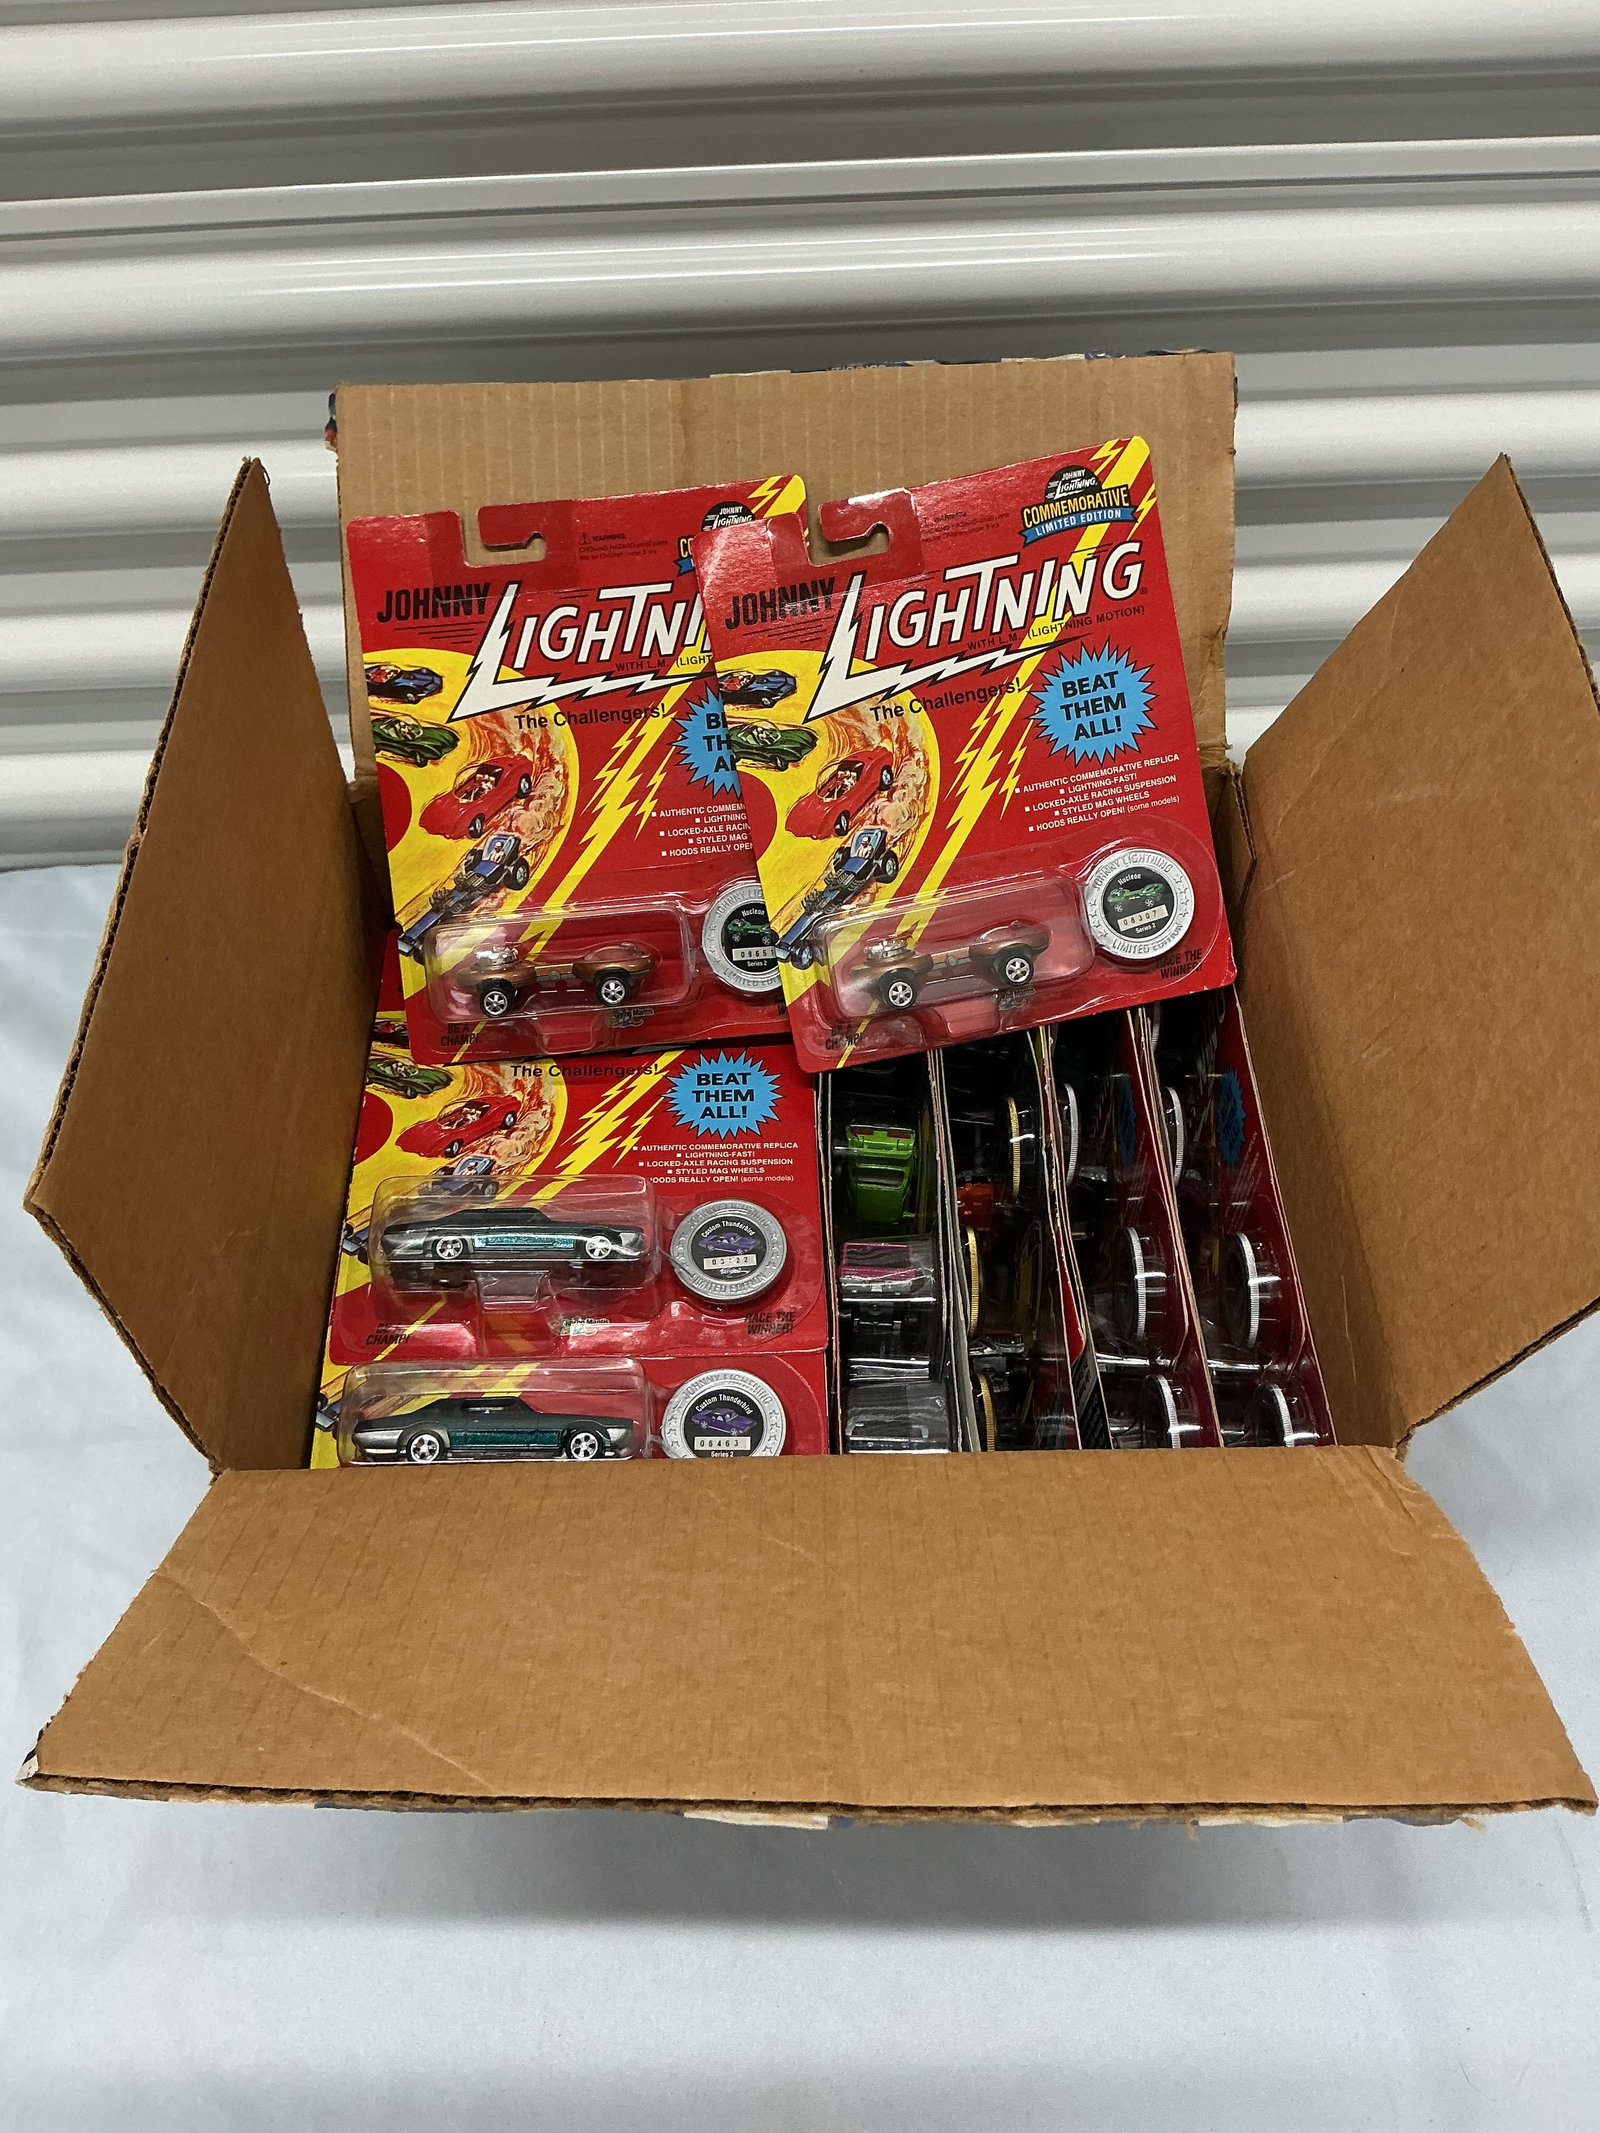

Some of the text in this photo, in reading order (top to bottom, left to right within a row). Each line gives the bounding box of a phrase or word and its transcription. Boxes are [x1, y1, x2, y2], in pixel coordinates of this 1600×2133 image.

[1061, 469, 1086, 480] JOHNNY
[1054, 477, 1096, 500] LIGHTNING
[719, 505, 743, 515] JOHNNY
[1022, 486, 1129, 528] COMMEMORATIVE
[1035, 509, 1121, 536] LIMITED EDITION
[377, 582, 491, 623] JOHNNY
[724, 543, 1144, 725] JOHNNY LIGHTNING
[967, 637, 998, 650] WITH
[1027, 617, 1093, 641] (LIGHTNING
[1095, 604, 1145, 623] MOTION)
[615, 660, 644, 672] WITH
[1061, 670, 1119, 699] BEAT
[869, 678, 1023, 721] The Challengers!
[1060, 692, 1127, 721] THEM
[514, 703, 667, 730] The Challengers!
[1073, 716, 1122, 741] ALL!
[1023, 753, 1180, 793] AUTHENTIC COMMEMORATIVE REPLICA
[1067, 772, 1138, 794] LIGHTNING-FAST!
[1032, 774, 1177, 812] LOCKED-AXLE RACING SUSPENSION
[1062, 790, 1150, 816] STYLED MAG WHEELS
[659, 806, 705, 818] AUTHENTIC
[1036, 795, 1180, 832] HOODS REALLY OPEN! (some models)
[667, 825, 725, 837] LOCKED-AXLE
[696, 832, 748, 845] STYLED MAG
[669, 847, 699, 857] HOODS
[699, 844, 732, 854] REALLY
[1092, 853, 1174, 891] JOHNNY LIGHTNING
[715, 891, 745, 918] JOHNNY
[1135, 924, 1152, 933] Series
[1112, 938, 1150, 954] LIMITED
[1184, 948, 1203, 961] THE
[511, 1063, 659, 1079] The Challengers!
[696, 1071, 752, 1086] BEAT
[691, 1088, 755, 1103] THEM
[699, 1105, 748, 1119] ALL!
[641, 1144, 687, 1152] AUTHENTIC
[689, 1142, 762, 1151] COMMEMORATIVE
[685, 1151, 755, 1159] LIGHTNING-FAST!
[646, 1160, 705, 1168] LOCKED-AXLE
[740, 1158, 793, 1166] SUSPENSION
[650, 1176, 677, 1184] OODS
[713, 1175, 739, 1183] OPEN!
[740, 1175, 763, 1183] (some
[765, 1174, 794, 1182] models)
[701, 1220, 756, 1238] Custom Thunderbird
[745, 1312, 773, 1323] RACE
[366, 1333, 409, 1345] CHAMP!
[695, 1393, 753, 1415] Custom Thunderbird
